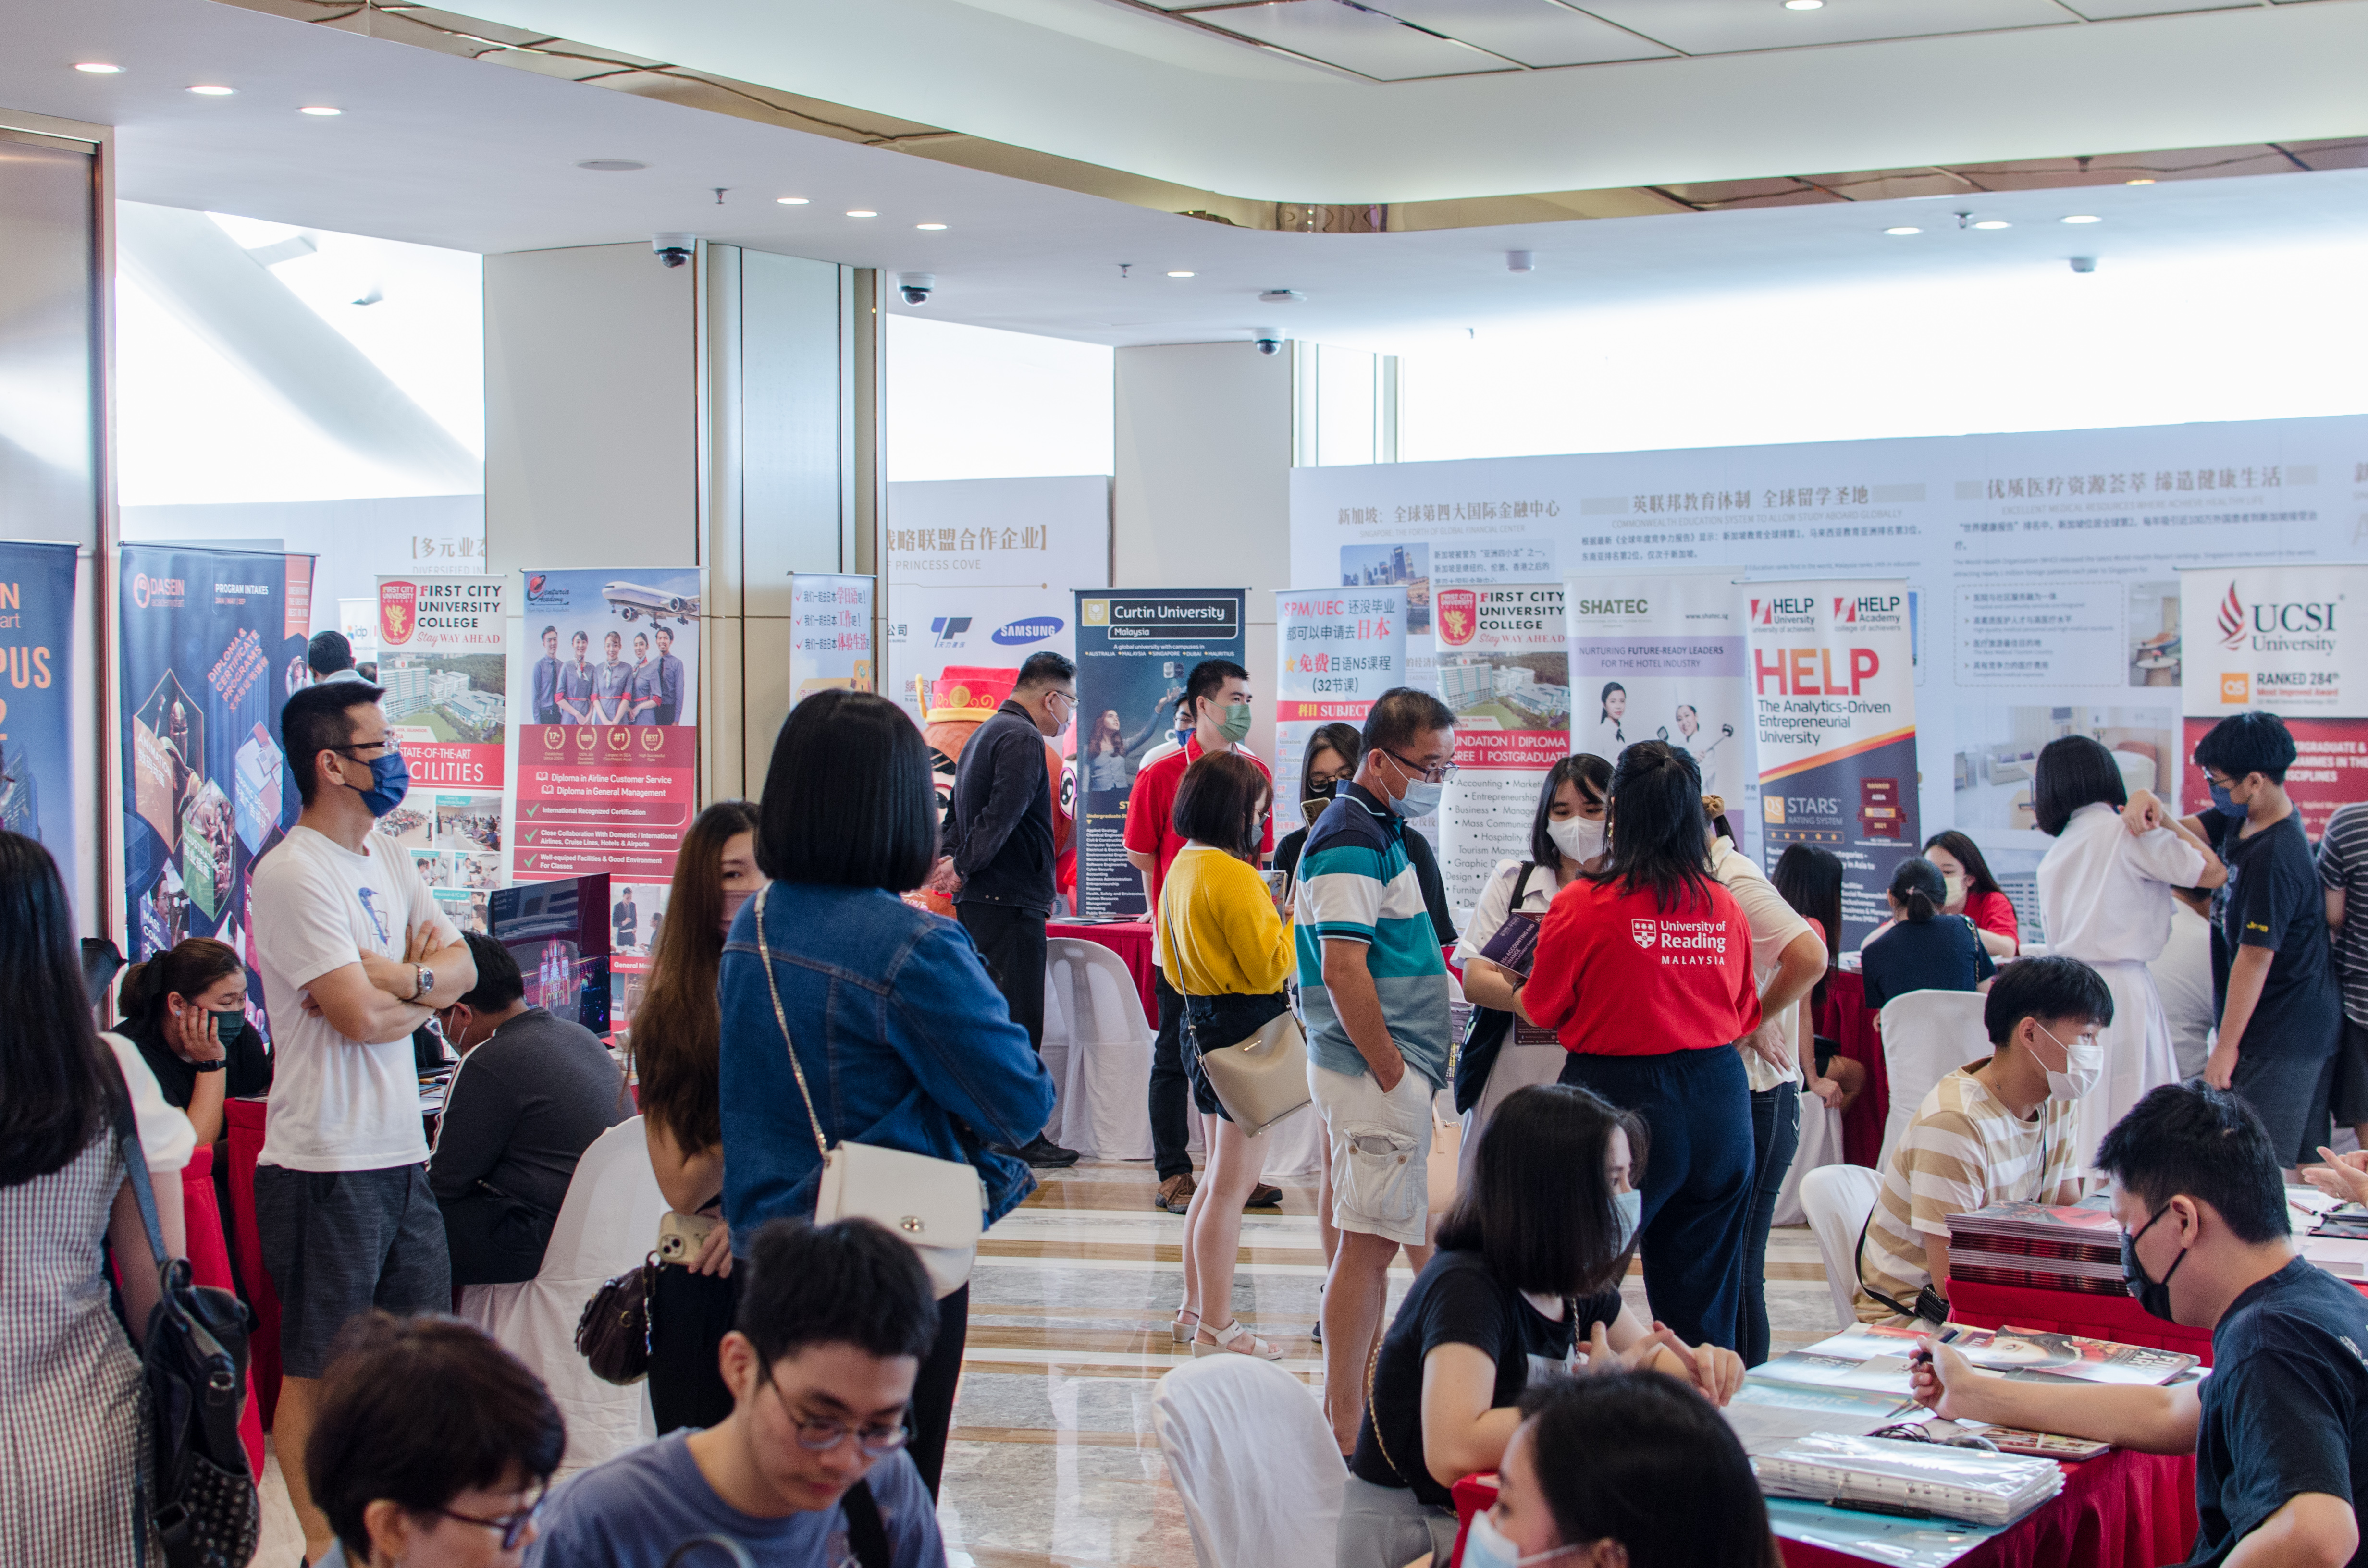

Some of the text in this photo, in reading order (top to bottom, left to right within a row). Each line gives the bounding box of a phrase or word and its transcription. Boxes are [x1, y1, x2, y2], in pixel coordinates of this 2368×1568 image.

[1633, 485, 1868, 513] 英联邦教育体制 全球留学圣地
[1394, 500, 1560, 523] 全球第四大国际金融中心
[1725, 514, 1754, 524] SYSTEM
[413, 566, 469, 574] DIVERSIFIED
[896, 559, 981, 570] PRINCESS COVE
[150, 578, 185, 596] DASEIN
[215, 583, 269, 595] PROGRAM INTAKES
[419, 585, 503, 598] FIRST CITY
[1480, 592, 1564, 602] FIRST CITY
[419, 602, 502, 613] UNIVERSITY
[1284, 598, 1395, 618] SPM/UEC 还没毕业
[1579, 599, 1649, 615] SHATEC
[1773, 598, 1814, 613] HELP
[1858, 597, 1900, 612] HELP
[1114, 606, 1225, 620] Curtin University
[1480, 607, 1565, 616] UNIVERSITY
[2251, 603, 2337, 633] UCSI
[418, 617, 479, 628] COLLEGE
[1774, 615, 1815, 624] University
[1859, 614, 1901, 623] Academy
[1000, 625, 1056, 637] SAMSUNG
[1286, 617, 1391, 641] 都可以申请去日本
[1480, 621, 1542, 630] COLLEGE
[355, 625, 368, 640] idp
[1114, 628, 1150, 637] Malaysia
[416, 631, 501, 648] Stay WAY AHEAD
[1479, 633, 1500, 647] Stay
[1526, 635, 1565, 643] AHEAD
[2252, 635, 2336, 656] University
[1628, 647, 1687, 655] FUTURE-READY
[1689, 646, 1724, 654] LEADERS
[207, 637, 241, 683] DIPLOMA
[216, 629, 260, 692] CERTIFICATE
[1601, 660, 1701, 668] FOR THE HOTEL INDUSTRY
[222, 645, 262, 702] PROGRAMS
[1754, 649, 1879, 696] HELP
[2257, 673, 2306, 686] RANKED
[2223, 680, 2246, 696] QS
[1298, 704, 1370, 717] 科目 SUBJECT
[1758, 700, 1891, 715] The Analytics-Driven
[1759, 715, 1850, 730] Entrepreneurial
[1455, 735, 1567, 747] UNDATION DIPLOMA
[1760, 731, 1820, 746] University
[400, 747, 472, 760] STATE-OF-THE-ART
[1487, 751, 1568, 763] POSTGRADUATE
[409, 761, 484, 782] CILITIES
[551, 774, 580, 784] Diploma
[588, 774, 609, 783] Airline
[610, 775, 645, 784] Customer
[645, 775, 672, 784] Service
[1456, 779, 1502, 789] Accounting
[557, 786, 585, 796] Diploma
[593, 787, 620, 796] General
[621, 788, 666, 798] Management
[1472, 793, 1538, 802] Entrepreneurship
[578, 808, 610, 816] Recognized
[1455, 806, 1489, 814] Business
[1765, 797, 1782, 816] QS
[1788, 797, 1838, 815] STARS
[1788, 816, 1843, 826] RATING SYSTEM
[1481, 833, 1523, 843] Hospitality
[1459, 845, 1489, 854] Tourism
[1454, 859, 1488, 869] Graphic
[1446, 872, 1472, 883] Design
[1660, 920, 1726, 933] University of
[1661, 932, 1726, 953] Reading
[614, 961, 638, 969] General
[1661, 956, 1725, 965] MALAYSIA
